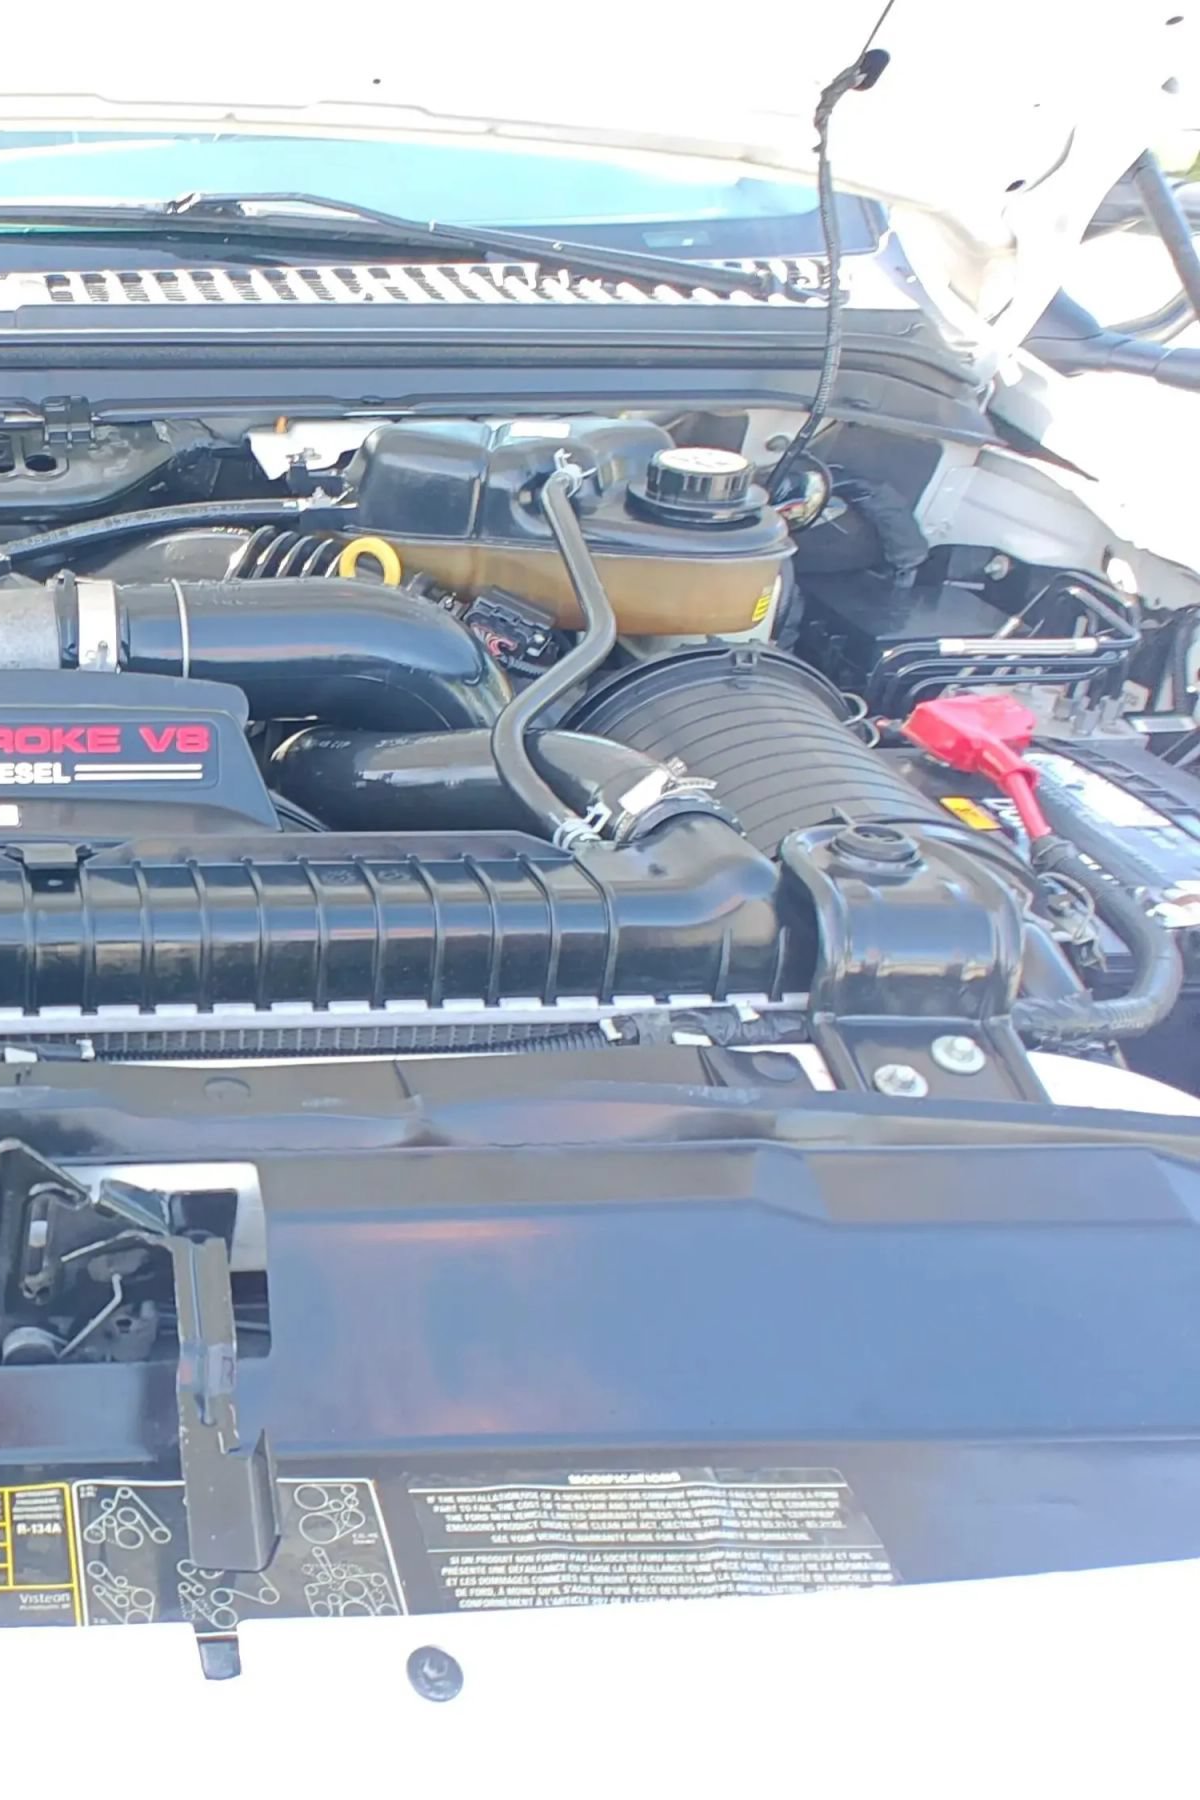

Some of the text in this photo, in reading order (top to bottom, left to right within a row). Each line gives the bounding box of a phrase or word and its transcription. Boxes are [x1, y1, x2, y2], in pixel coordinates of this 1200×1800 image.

[140, 726, 209, 754] V8
[16, 1523, 62, 1535] R-134A
[19, 1592, 71, 1604] Visteon
